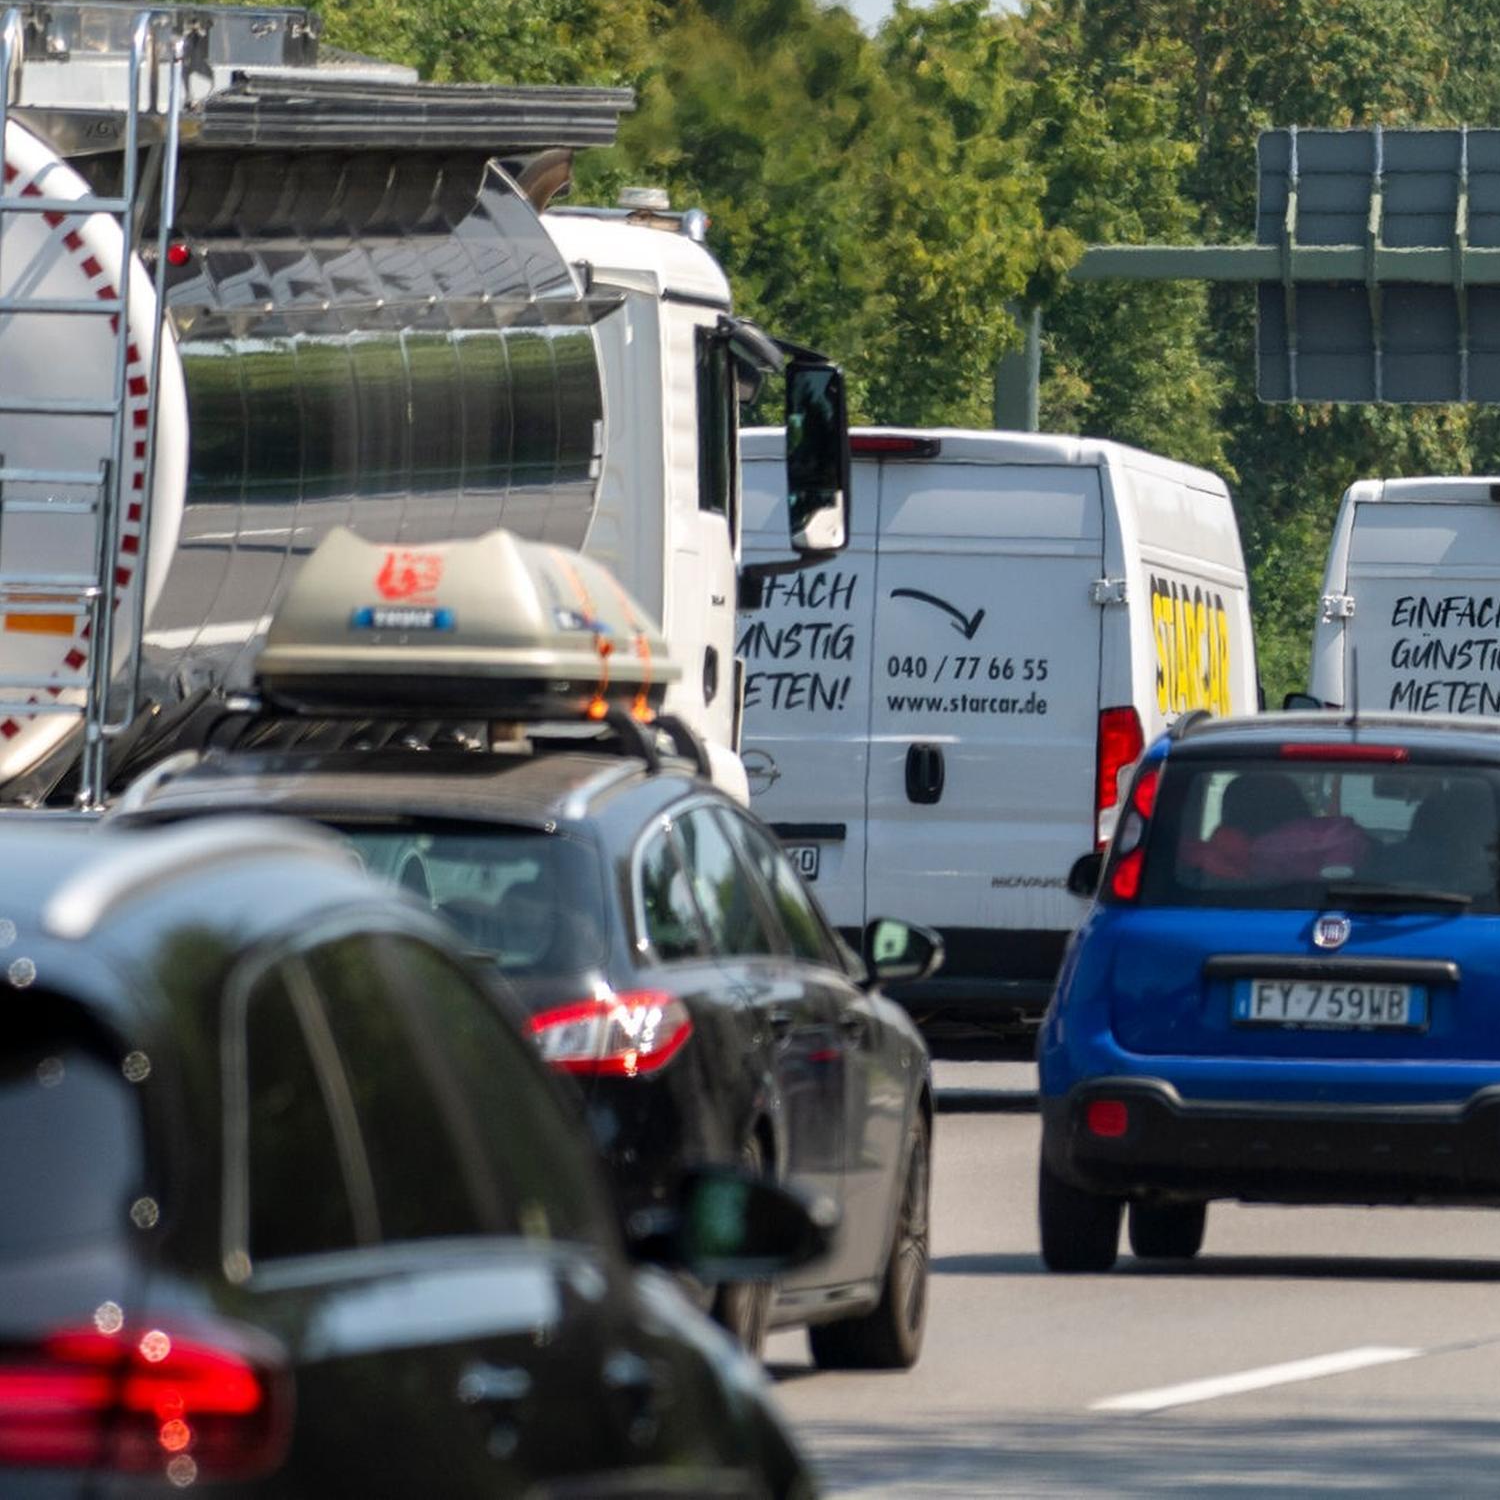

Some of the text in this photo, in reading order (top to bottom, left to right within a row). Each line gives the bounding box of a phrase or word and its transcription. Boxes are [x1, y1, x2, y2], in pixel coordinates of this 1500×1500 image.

[764, 571, 857, 610] FACH
[736, 614, 855, 661] ÜNSTIG
[1150, 573, 1233, 718] STARCAR
[887, 655, 927, 678] 040
[953, 656, 981, 680] 77
[988, 657, 1014, 680] 66
[1022, 658, 1048, 681] 55
[743, 671, 852, 711] ETEN!
[887, 691, 1048, 715] www.starcar.de
